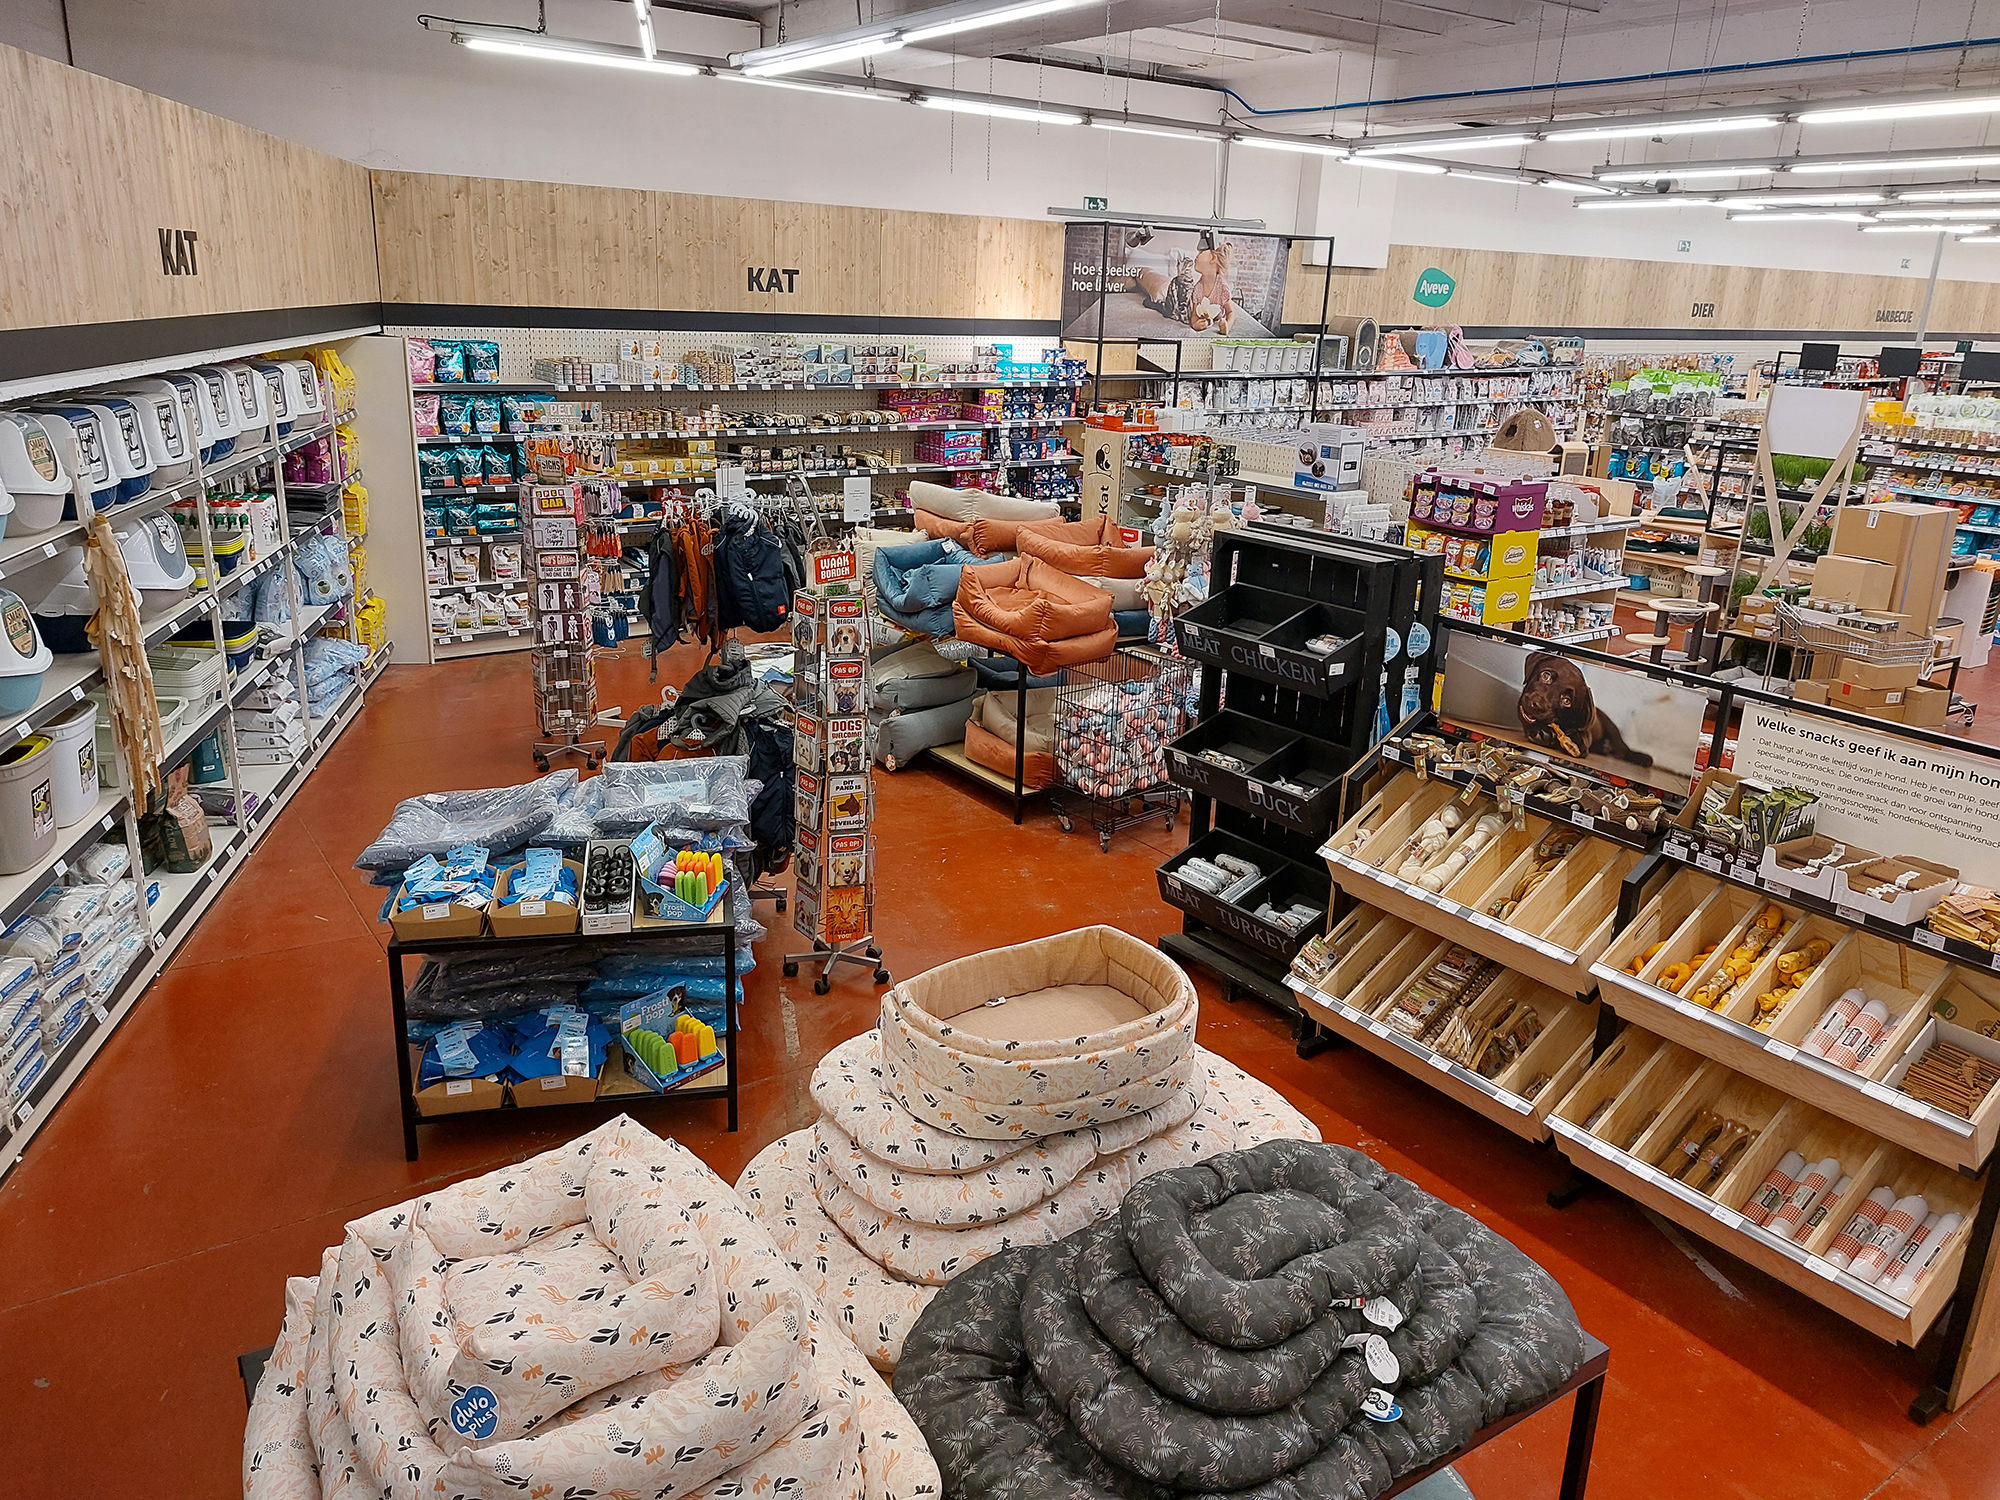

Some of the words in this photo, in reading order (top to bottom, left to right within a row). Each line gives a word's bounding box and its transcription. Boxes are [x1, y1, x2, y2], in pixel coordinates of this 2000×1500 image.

[158, 228, 198, 276] KAT
[1073, 262, 1095, 276] Hoe
[1098, 264, 1142, 278] seelser,
[748, 267, 800, 293] KAT
[1072, 278, 1092, 291] hoe
[1096, 279, 1126, 292] liver.
[1420, 280, 1449, 296] Aveve
[1692, 303, 1714, 317] DIER
[1876, 310, 1913, 322] BARBECUE
[550, 404, 572, 415] PET
[428, 466, 449, 475] ONE
[464, 465, 480, 473] ONE
[542, 460, 560, 470] SIGNS
[542, 498, 563, 508] BAR
[1099, 486, 1109, 514] Kat
[1512, 503, 1534, 512] whiskas
[820, 555, 849, 570] WAAK
[821, 566, 850, 580] BORDEN
[1458, 604, 1473, 616] 3+1
[1182, 632, 1220, 656] MEAT
[1231, 646, 1317, 686] CHICKEN
[832, 720, 862, 732] DOGS
[1756, 716, 1796, 735] Welke
[1799, 729, 1845, 748] snacks
[1848, 742, 1881, 757] geef
[1884, 748, 1896, 761] ik
[1900, 756, 1927, 769] aan
[1931, 764, 1965, 779] mijn
[1969, 771, 2000, 788] hon
[1172, 760, 1209, 785] MEAT
[1759, 738, 1771, 747] Dat
[1774, 742, 1794, 754] hangt
[1820, 755, 1830, 763] de
[1832, 757, 1858, 770] leeftijd
[1859, 765, 1873, 774] van
[1874, 769, 1882, 777] je
[1885, 770, 1907, 784] hond.
[1910, 779, 1928, 789] Heb
[1939, 788, 1955, 797] een
[1958, 793, 1976, 803] pup,
[1980, 799, 1999, 808] geef
[1757, 748, 1785, 761] speciale
[1787, 757, 1836, 776] puppysnacks.
[1839, 770, 1852, 780] Die
[1854, 774, 1909, 795] ondersteunen
[1911, 791, 1921, 799] de
[1924, 795, 1945, 806] groei
[1948, 801, 1962, 810] van
[1964, 804, 1973, 814] je
[1975, 808, 2000, 821] hond.
[1752, 771, 1762, 779] De
[1765, 774, 1785, 786] keuze
[1819, 790, 1885, 816] trainingssnoepjes,
[1888, 810, 1952, 835] hondenkoekjes,
[1754, 761, 1772, 771] Geef
[1774, 767, 1790, 776] voor
[1792, 771, 1819, 786] training
[1821, 781, 1835, 789] een
[1837, 785, 1864, 798] andere
[1866, 792, 1889, 805] snack
[1891, 800, 1906, 810] dan
[1908, 806, 1927, 815] voor
[1929, 812, 1983, 833] ontspanning.
[1250, 791, 1303, 823] DUCK
[1825, 804, 1845, 814] hond
[1847, 811, 1861, 819] wat
[1863, 816, 1880, 825] wils.
[645, 838, 657, 853] Frosti
[1165, 882, 1200, 909] MEAT
[1216, 906, 1287, 954] TURKEY
[641, 999, 670, 1015] Frosti
[646, 1007, 665, 1023] pop
[456, 1397, 489, 1428] duvo
[469, 1410, 494, 1435] plus
